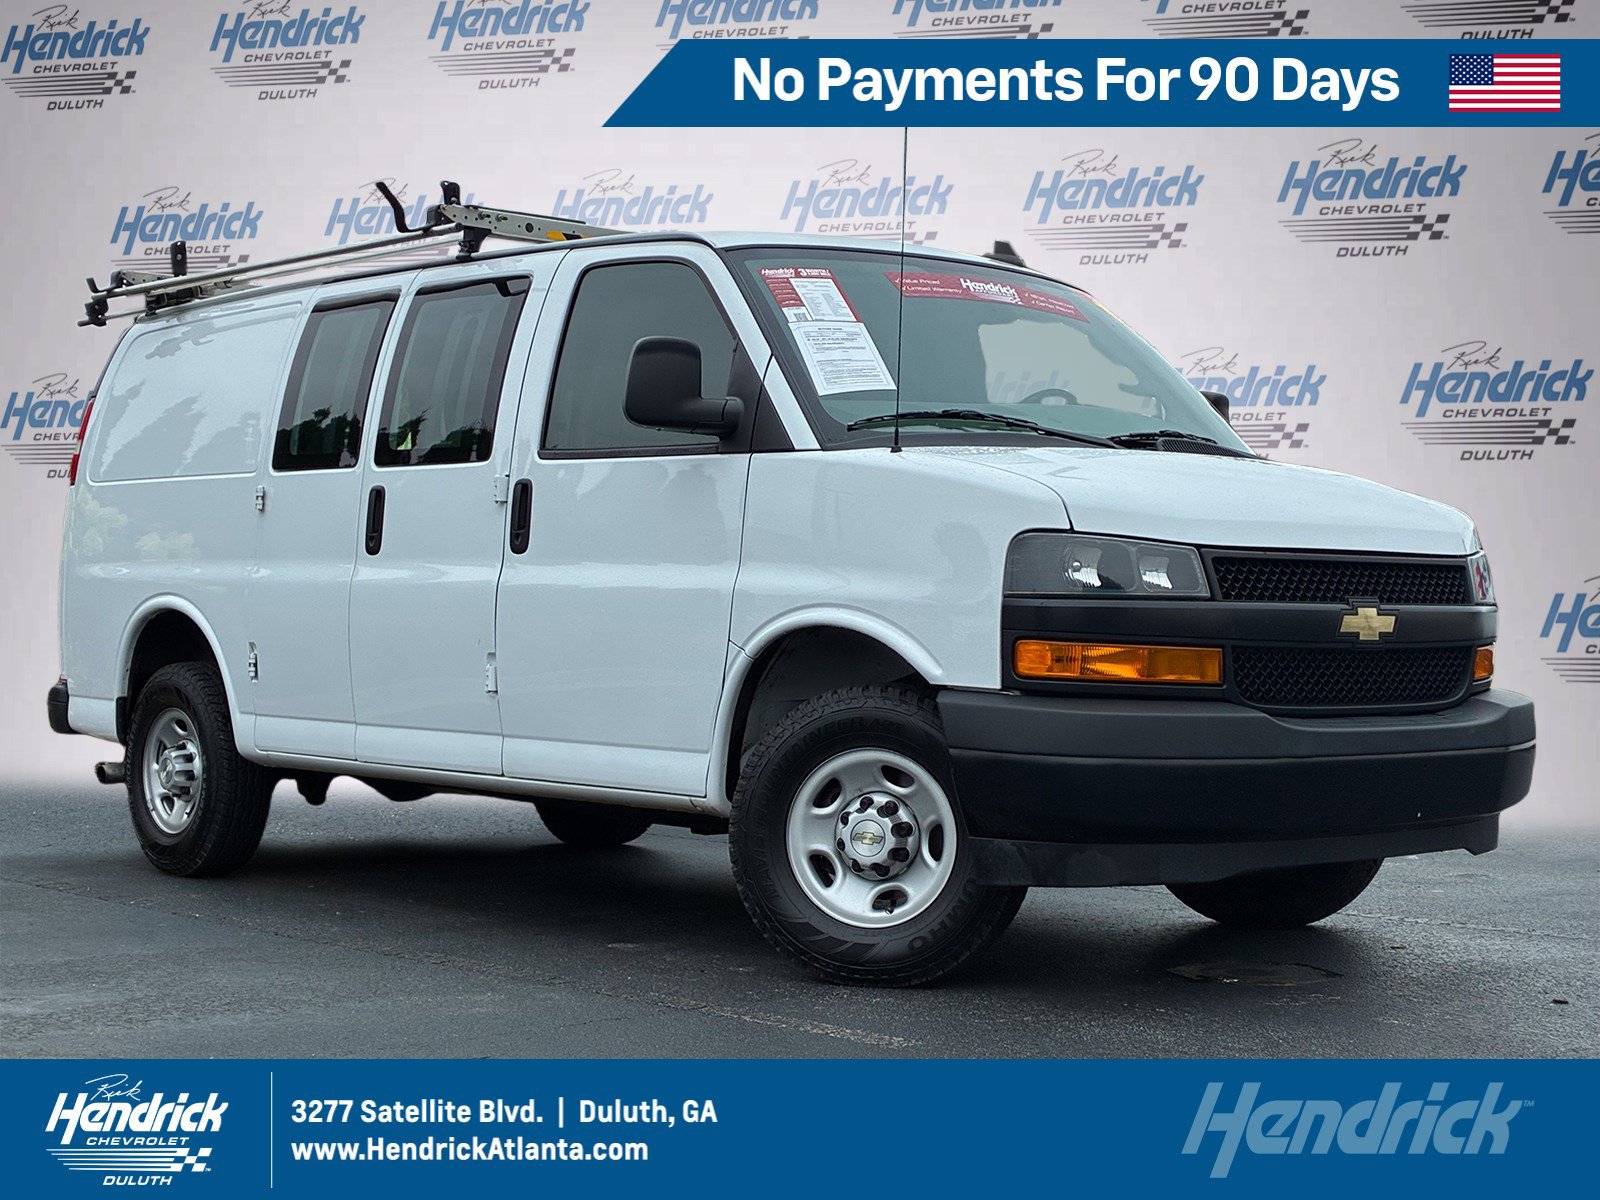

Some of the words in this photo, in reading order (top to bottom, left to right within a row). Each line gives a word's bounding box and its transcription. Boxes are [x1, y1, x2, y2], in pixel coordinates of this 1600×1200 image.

[1181, 0, 1287, 14] CHEVROLET
[427, 0, 591, 51] Hendrick
[931, 13, 1031, 27] CHEVROLET
[209, 6, 366, 63] Hendrick
[692, 26, 788, 39] CHEVROLET
[0, 18, 150, 74] Hendrick
[464, 38, 556, 51] CHEVROLET
[244, 50, 332, 63] CHEVROLET
[33, 61, 118, 74] CHEVROLET
[478, 77, 541, 90] DULUTH
[258, 88, 318, 101] DULUTH
[46, 99, 104, 111] DULUTH
[1276, 154, 1468, 216] Hendrick
[1022, 165, 1205, 224] Hendrick
[551, 184, 713, 227] Hendrick
[779, 175, 954, 232] Hendrick
[1319, 203, 1427, 216] CHEVROLET
[1062, 212, 1165, 225] CHEVROLET
[110, 201, 264, 256] Hendrick
[818, 221, 916, 233] CHEVROLET
[144, 244, 231, 256] CHEROLET
[1336, 245, 1408, 257] DULUTH
[1079, 253, 1148, 266] DULUTH
[959, 278, 1018, 298] Hendrick
[1400, 359, 1594, 418] Hendrick
[1442, 407, 1552, 418] CHEVROLET
[1460, 450, 1534, 461] DULUTH
